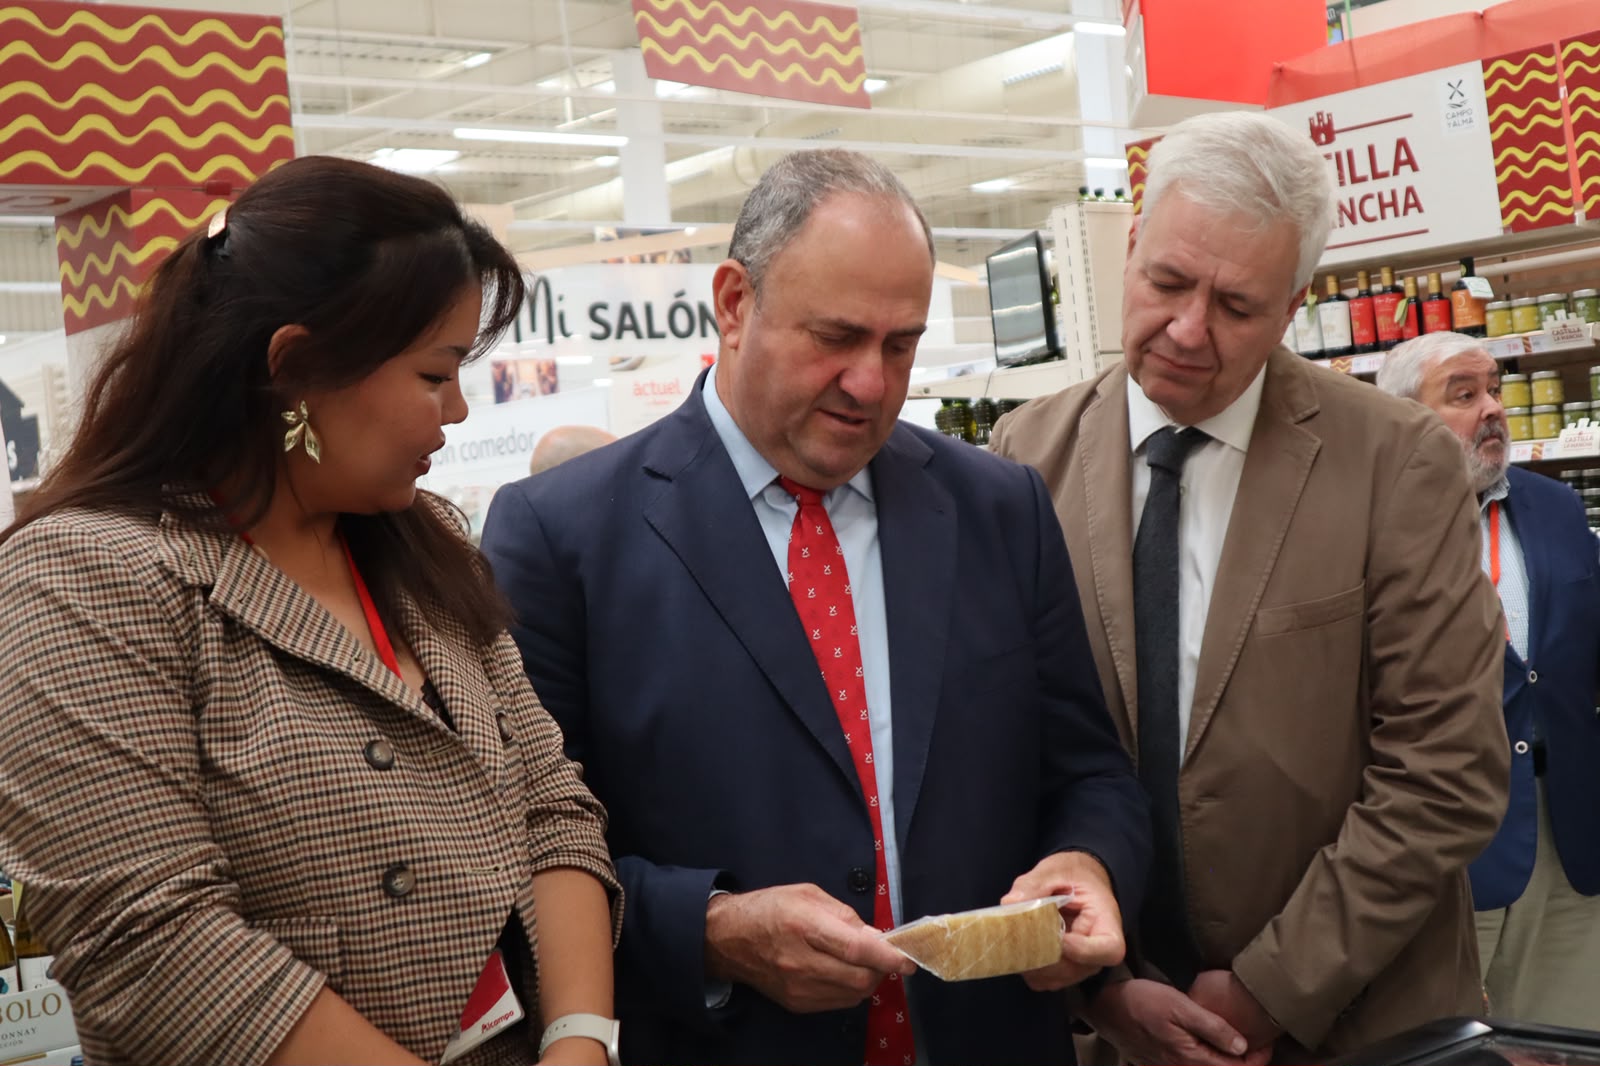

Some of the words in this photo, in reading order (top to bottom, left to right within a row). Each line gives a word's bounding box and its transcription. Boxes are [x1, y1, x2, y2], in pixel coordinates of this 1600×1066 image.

[1445, 108, 1473, 120] CAMPO
[1323, 136, 1420, 187] ILLA
[514, 276, 573, 344] Mi
[1551, 327, 1582, 336] CASTILLA
[459, 426, 536, 462] comedor
[1565, 435, 1594, 443] CASTILLA
[481, 1010, 515, 1034] Alcampo
[1, 1026, 37, 1040] ONNAY
